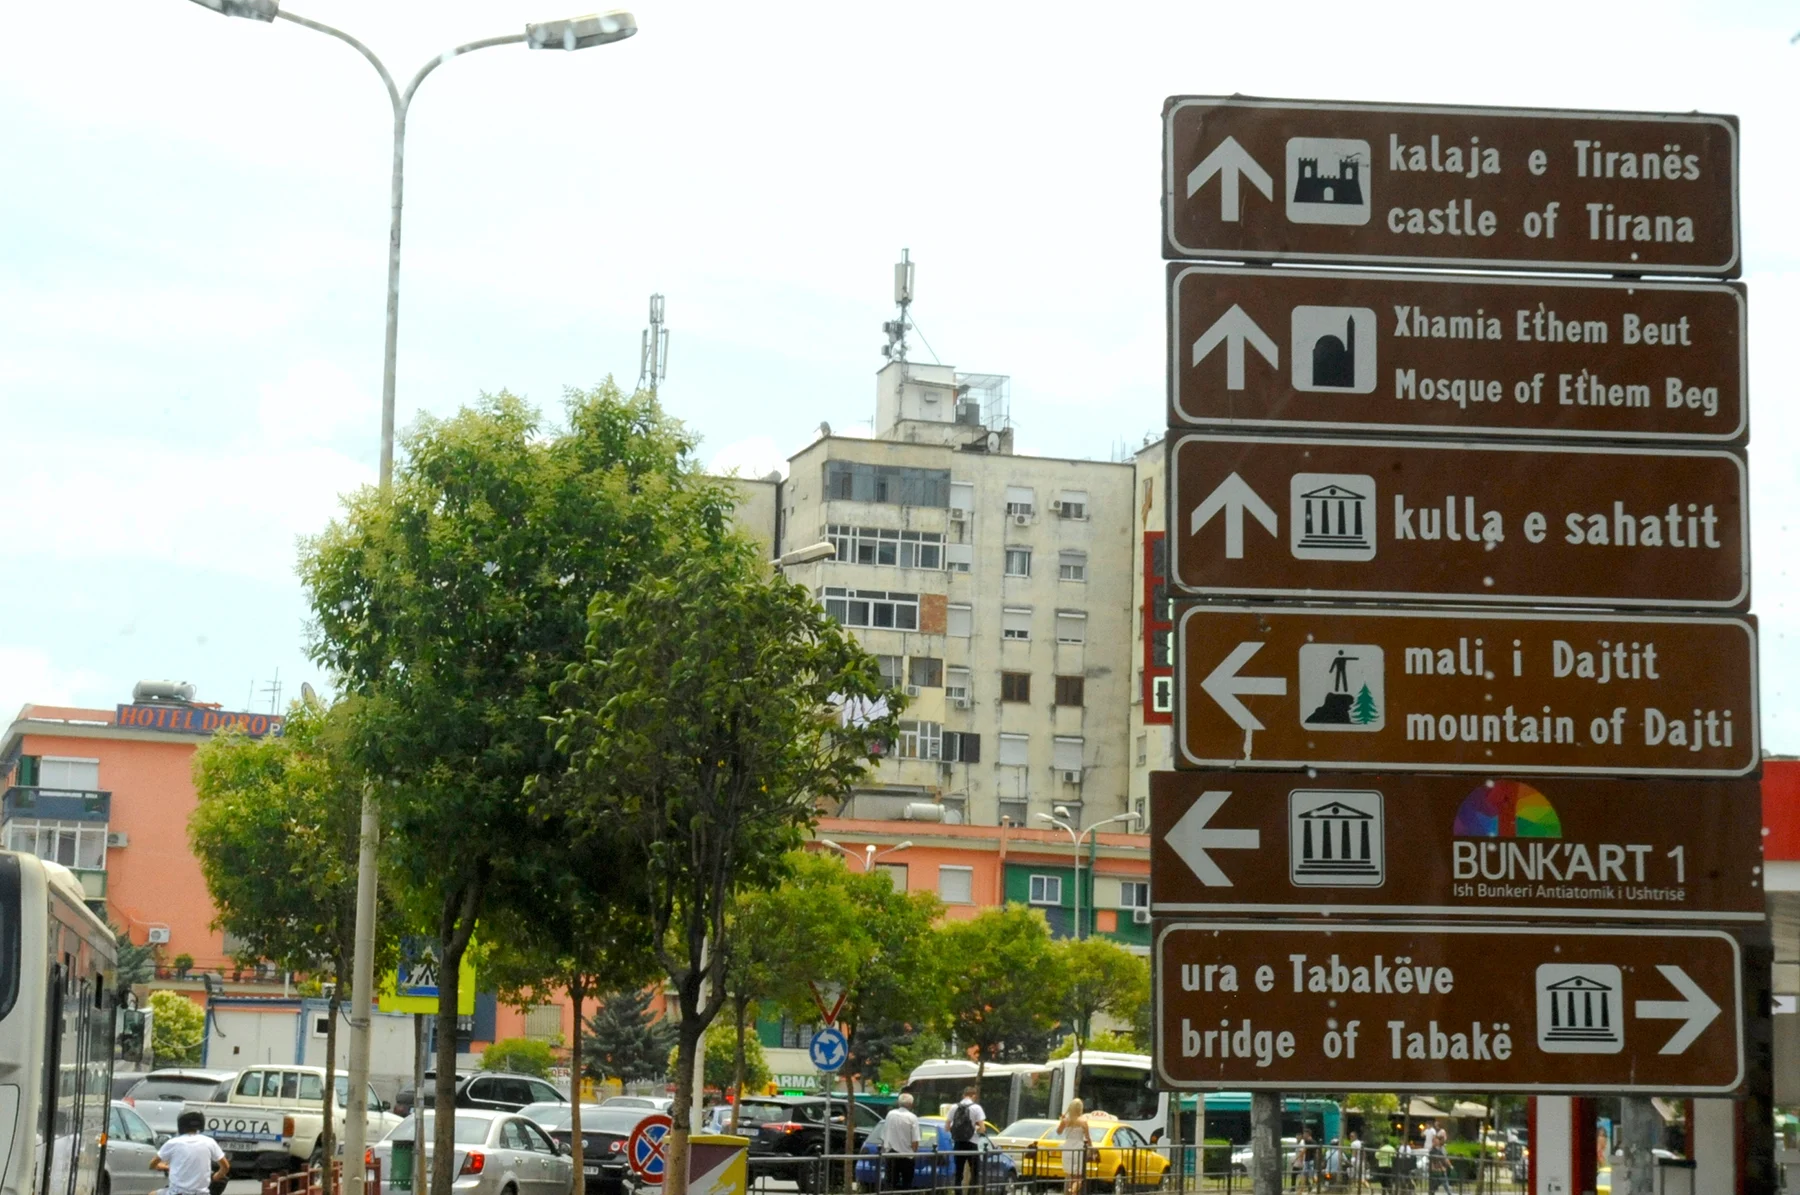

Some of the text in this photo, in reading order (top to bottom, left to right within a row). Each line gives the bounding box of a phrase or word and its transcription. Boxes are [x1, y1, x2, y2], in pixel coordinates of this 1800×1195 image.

[1390, 134, 1699, 180] kalaja e Tiranës
[1388, 199, 1694, 242] castle of Tirana
[1394, 302, 1691, 345] Xhamia Ethem Beut
[1396, 369, 1717, 416] Mosque of Ethem Beg
[1395, 495, 1720, 548] kulla e sahatit
[1405, 638, 1659, 683] mali i Dajtit
[119, 706, 195, 729] HOTEL
[1407, 706, 1732, 751] mountain of Dajti
[1453, 842, 1684, 882] BUNK'ART 1
[1454, 883, 1473, 897] Ish
[1478, 883, 1532, 897] Bunkeri
[1536, 885, 1615, 898] Antiatomik
[1626, 887, 1685, 901] Ushtrisë
[1182, 955, 1453, 993] ura e Tabakëve
[1182, 1019, 1511, 1067] bridge of Tabakë
[207, 1118, 270, 1134] OYOTA
